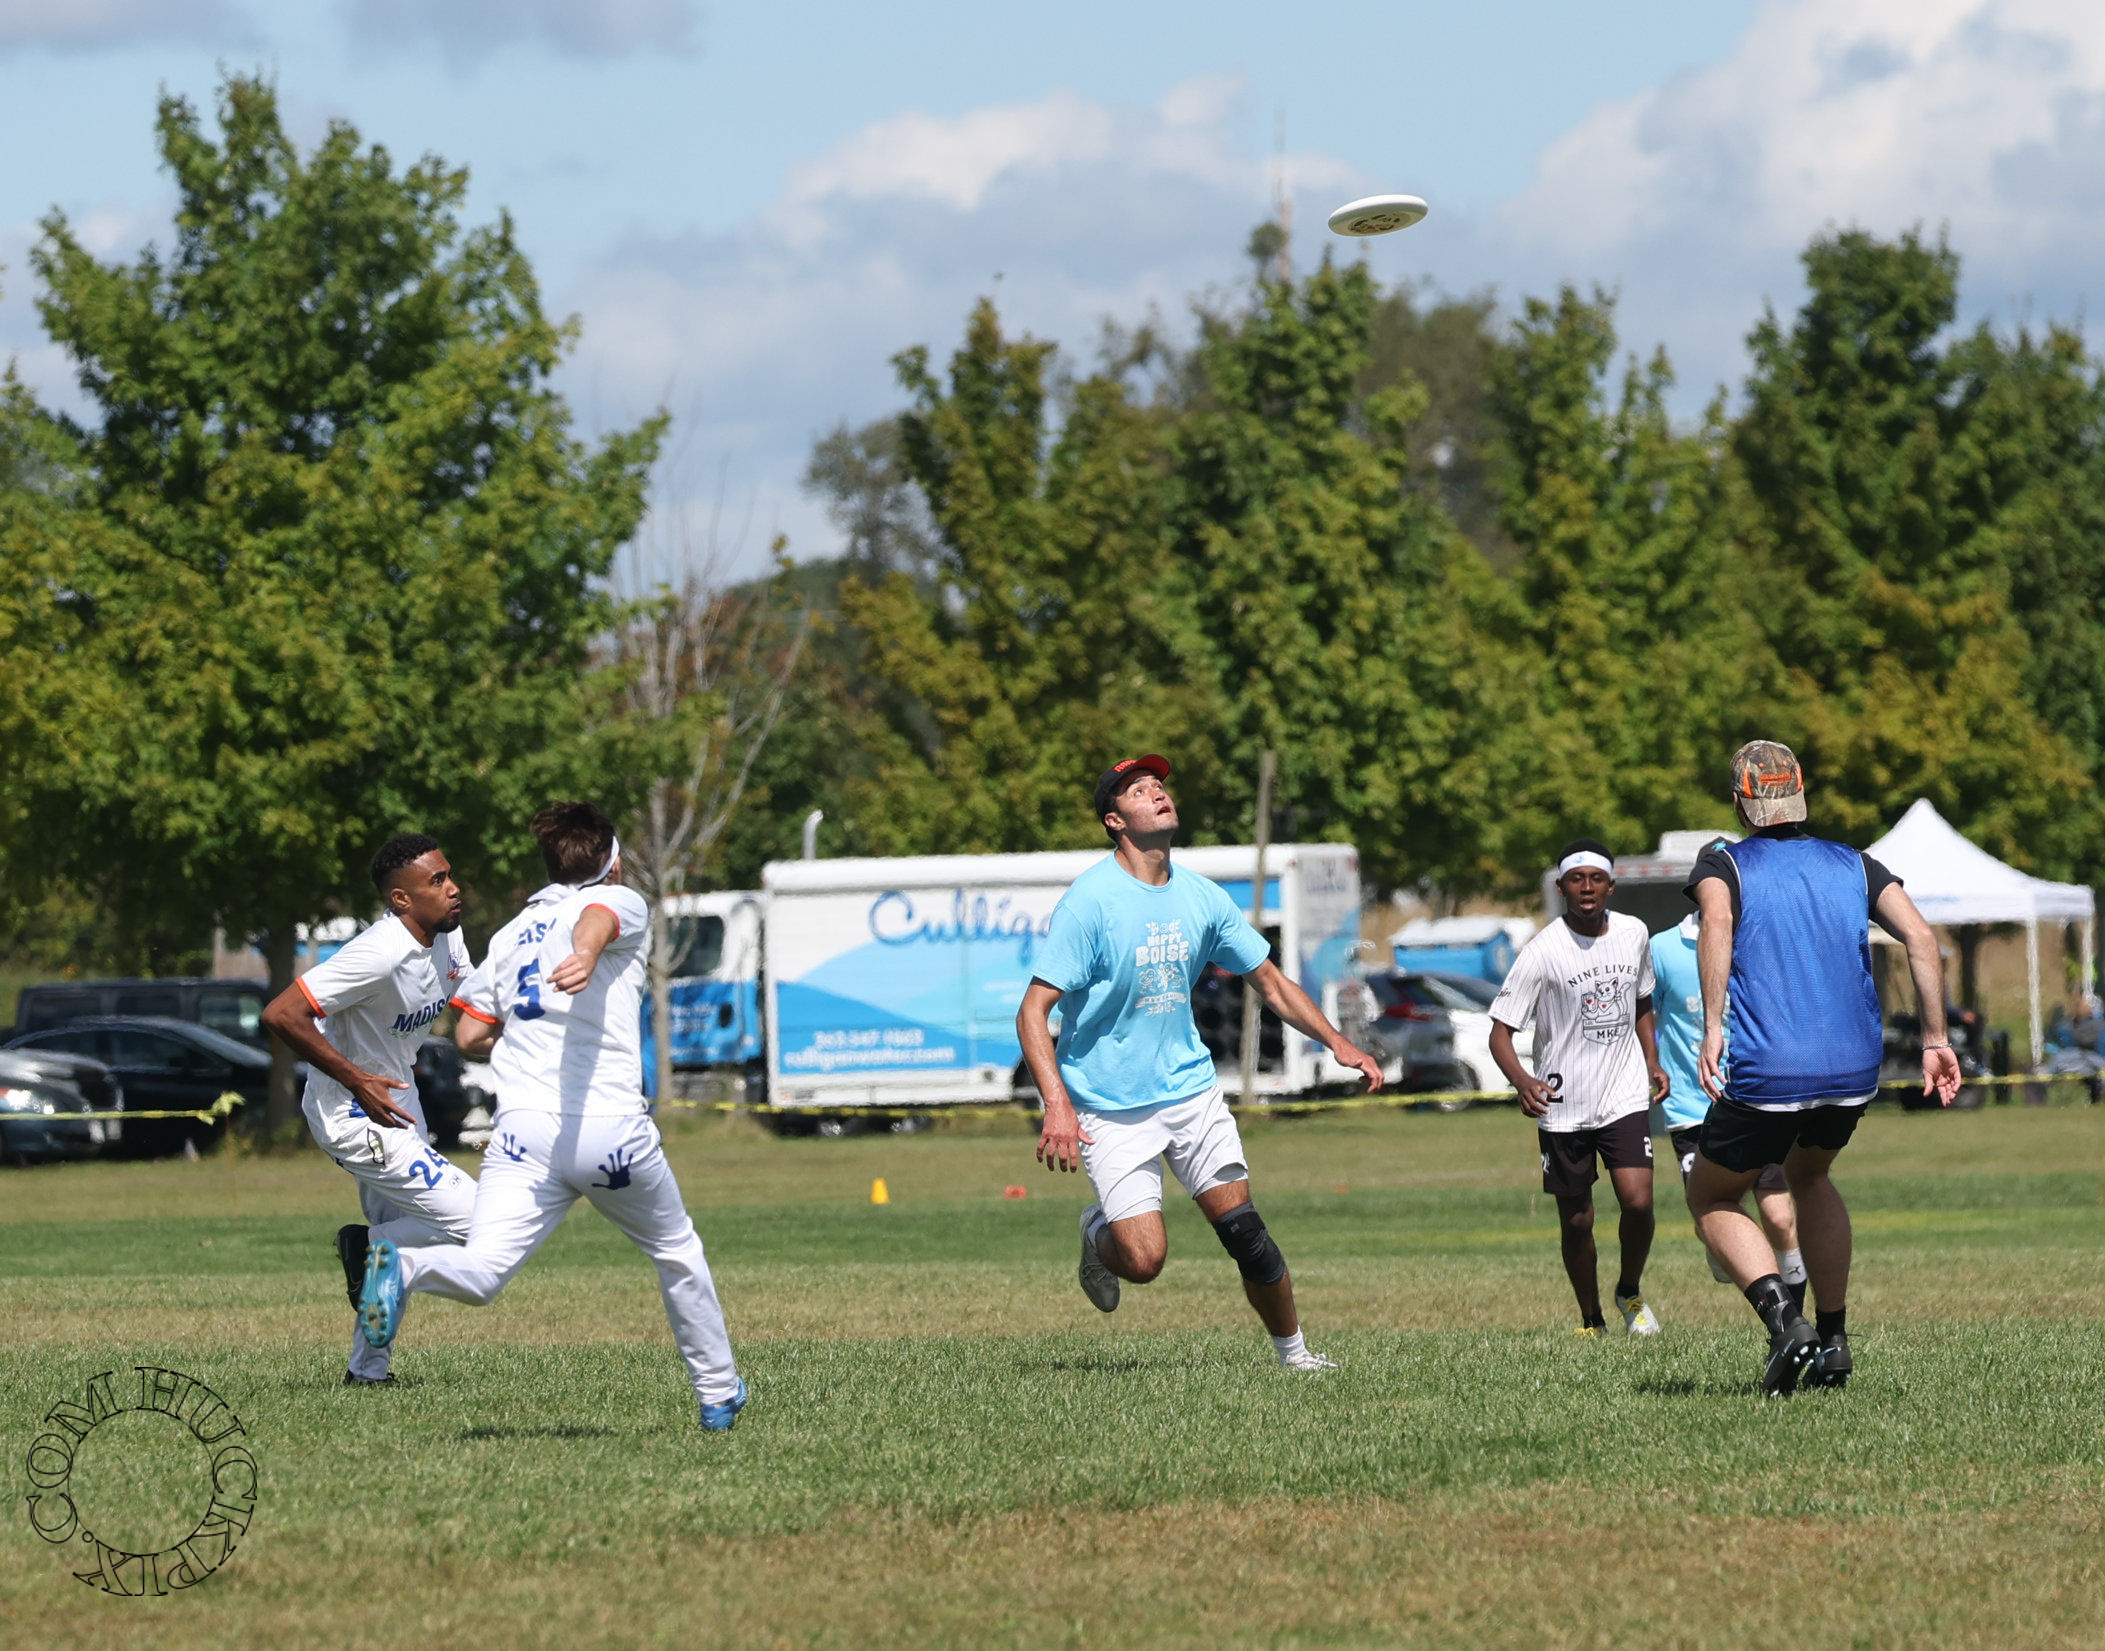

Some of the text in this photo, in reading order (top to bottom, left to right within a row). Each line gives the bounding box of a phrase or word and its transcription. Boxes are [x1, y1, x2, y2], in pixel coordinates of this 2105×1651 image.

[1147, 932, 1182, 947] HAPPY
[1135, 940, 1190, 967] BOISE
[1568, 964, 1639, 988] NINE LIVES
[514, 958, 546, 1021] 5
[393, 994, 451, 1033] MADIS
[1597, 1028, 1620, 1039] MKE
[1547, 1073, 1564, 1104] 2
[1643, 1136, 1654, 1158] 2
